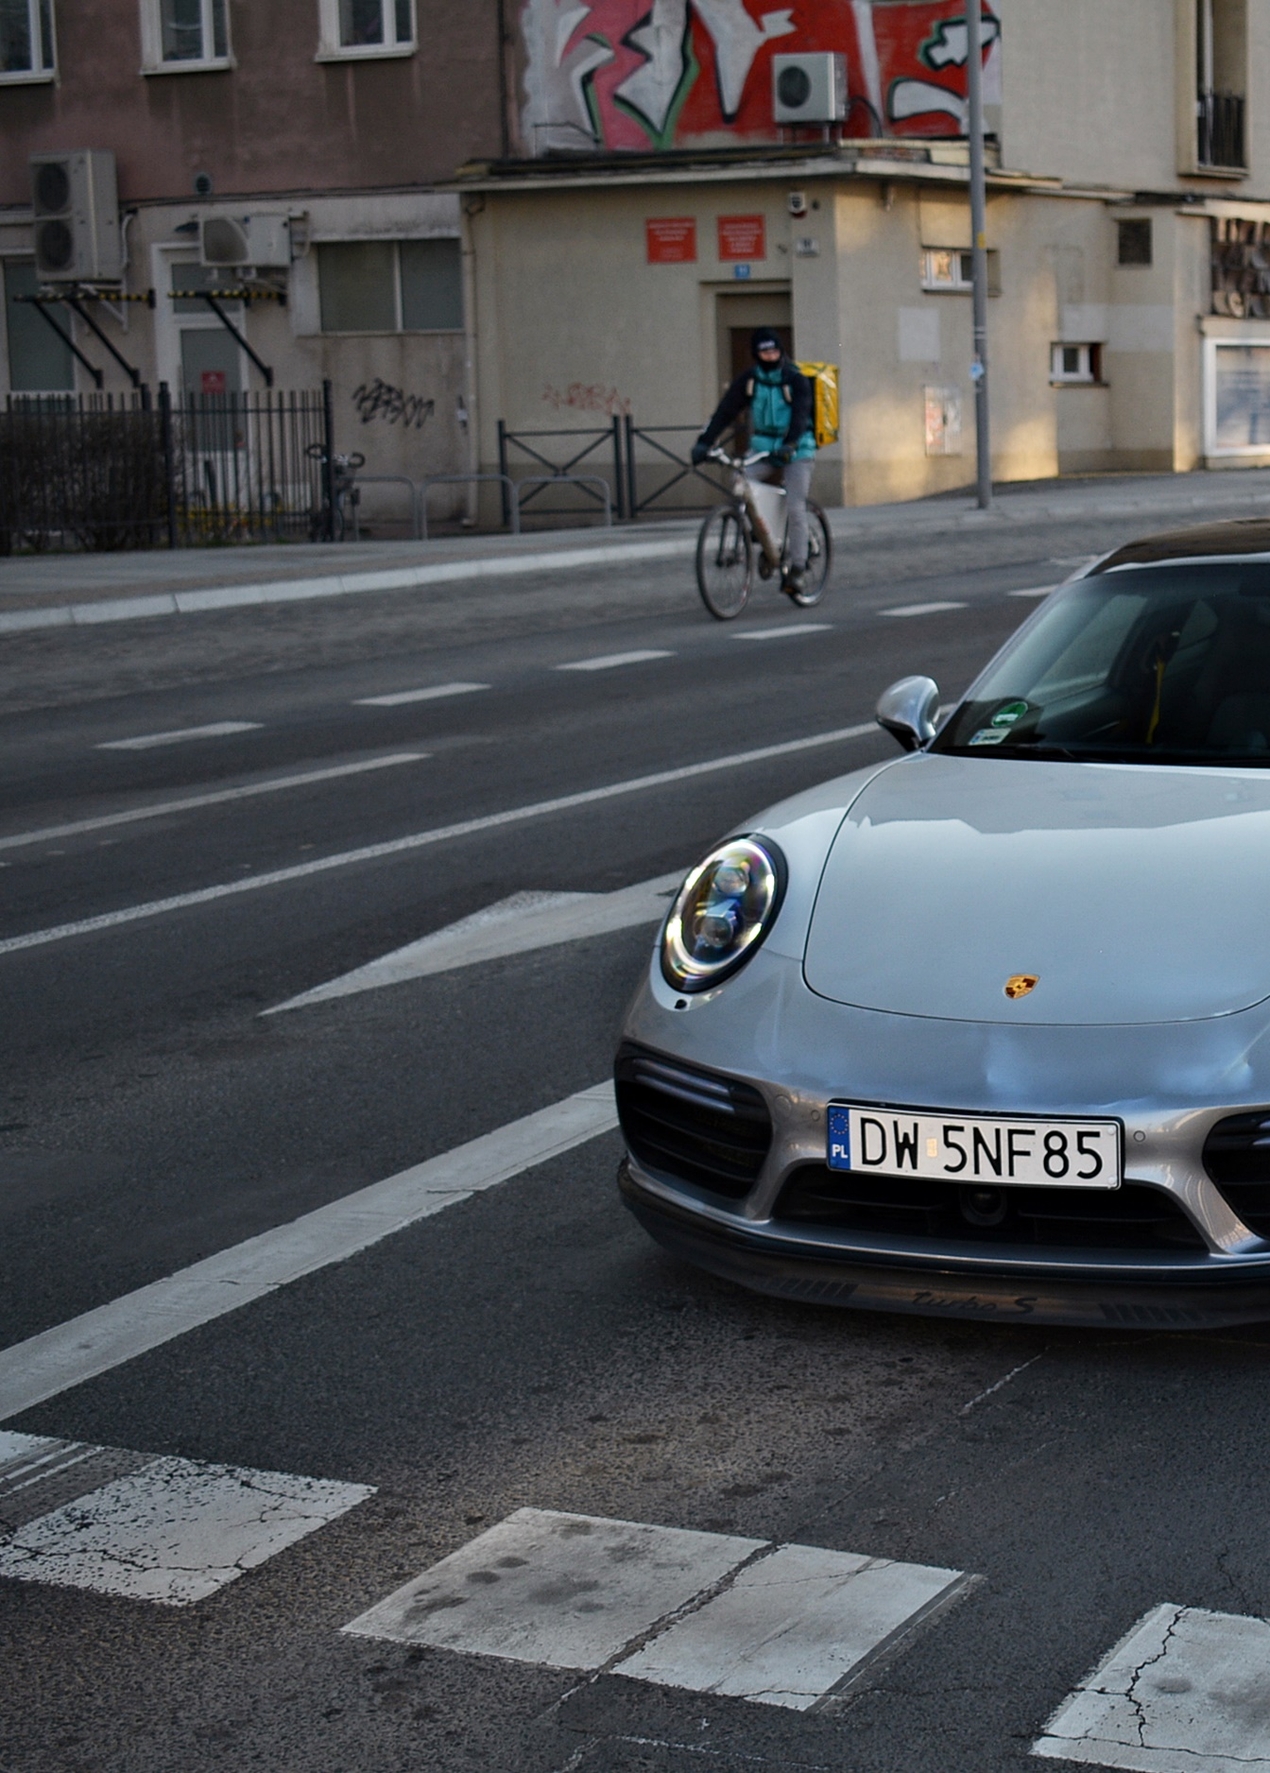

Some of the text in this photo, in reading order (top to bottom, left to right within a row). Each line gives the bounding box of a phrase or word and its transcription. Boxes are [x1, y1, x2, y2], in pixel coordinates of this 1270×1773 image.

[831, 1143, 849, 1160] PL
[860, 1116, 1103, 1180] DW 5NF85
